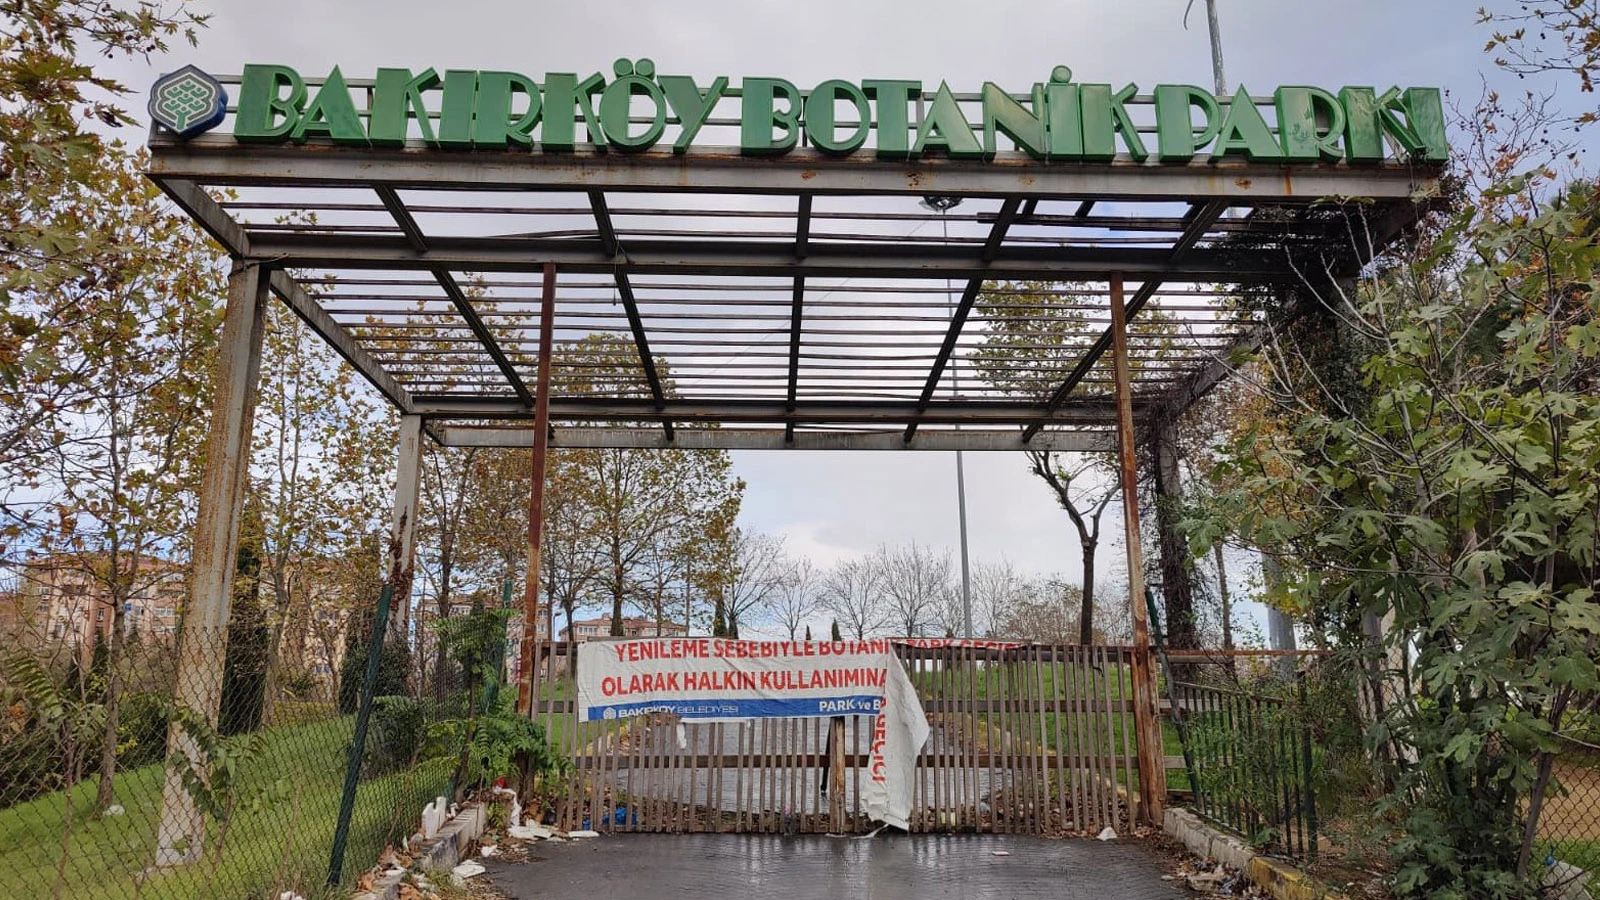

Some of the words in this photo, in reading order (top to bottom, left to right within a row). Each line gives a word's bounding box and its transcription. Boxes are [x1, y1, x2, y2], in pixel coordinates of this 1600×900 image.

[233, 58, 729, 153] BAKIRKÖY
[740, 65, 1148, 163] BOTANİK
[601, 671, 679, 697] OLARAK
[683, 669, 756, 692] HALKIN
[819, 698, 856, 712] PARK
[857, 702, 871, 711] ve
